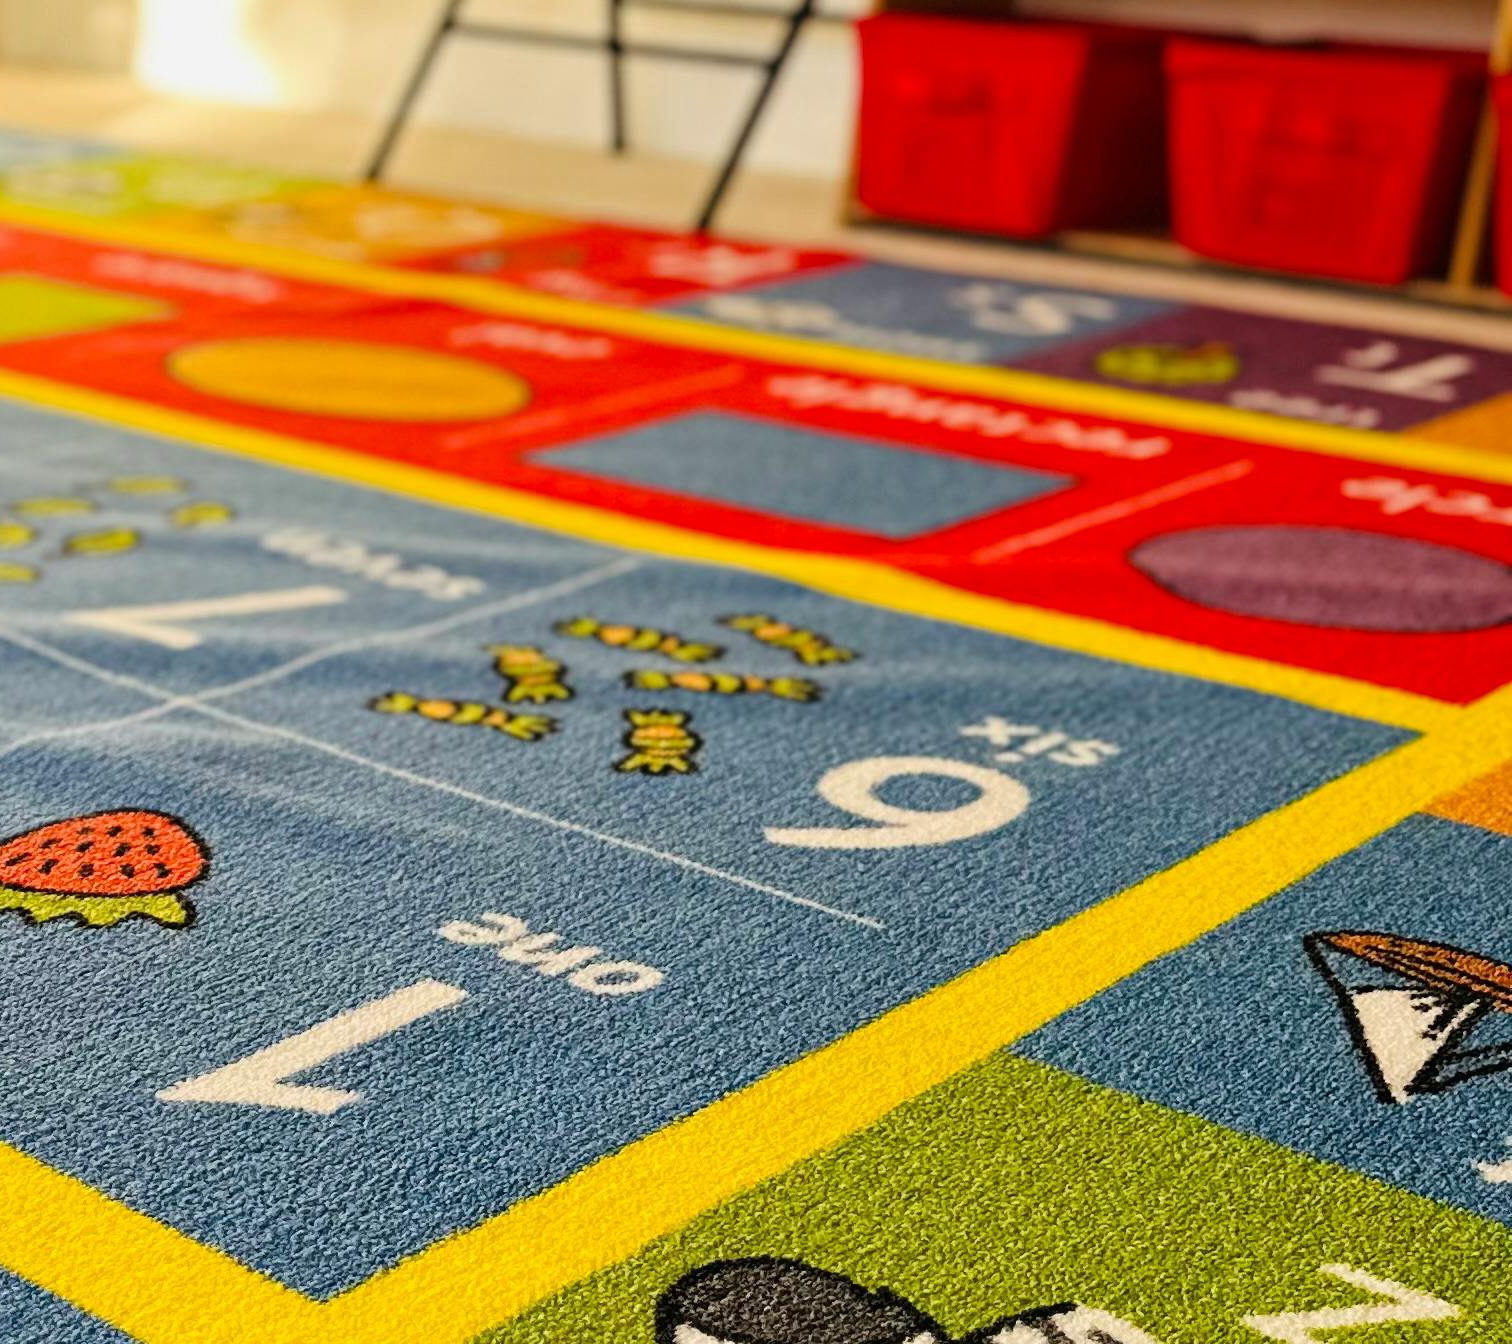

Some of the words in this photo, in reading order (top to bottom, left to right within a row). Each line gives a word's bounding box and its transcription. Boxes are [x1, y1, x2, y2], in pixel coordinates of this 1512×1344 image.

[766, 374, 1171, 459] rectangle
[63, 585, 348, 649] 7
[960, 714, 1120, 766] six
[763, 756, 1031, 850] 6
[438, 911, 664, 997] one
[156, 976, 468, 1115] 1
